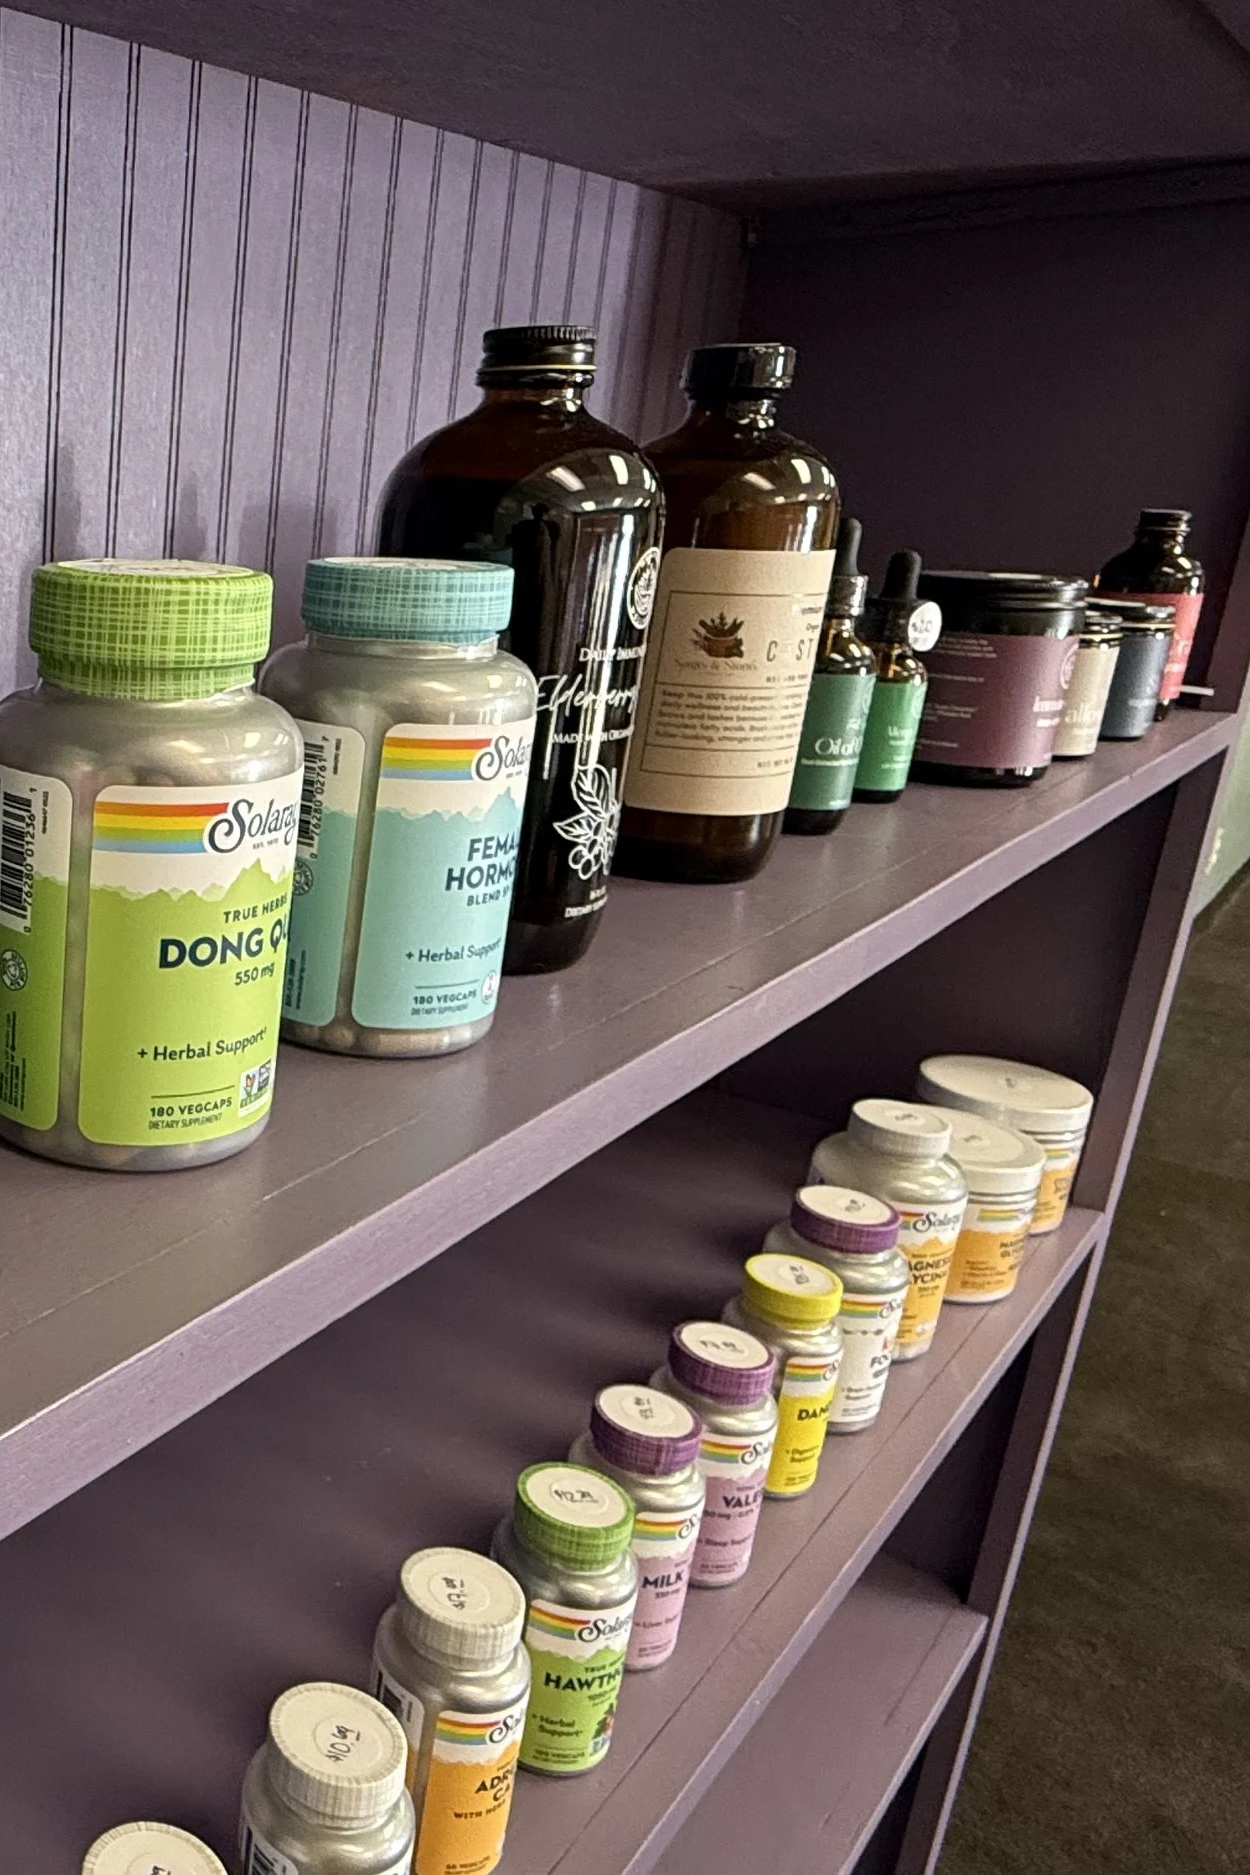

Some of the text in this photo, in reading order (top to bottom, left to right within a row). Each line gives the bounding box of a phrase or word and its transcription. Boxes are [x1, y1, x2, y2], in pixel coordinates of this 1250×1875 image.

[25, 812, 36, 858] 01236
[23, 863, 34, 907] 76280
[223, 892, 288, 924] TRUE HERBS
[467, 889, 501, 907] BLEND
[159, 927, 263, 969] DONG
[418, 945, 464, 962] Herbal
[235, 962, 275, 986] 550 mg
[414, 989, 477, 1005] 180 VEGCAPS
[153, 1041, 211, 1061] Herbal
[150, 1096, 232, 1117] 180 VEGCAPS
[641, 1570, 684, 1589] MILK
[539, 1714, 576, 1728] Herbal
[453, 1811, 483, 1820] WITH
